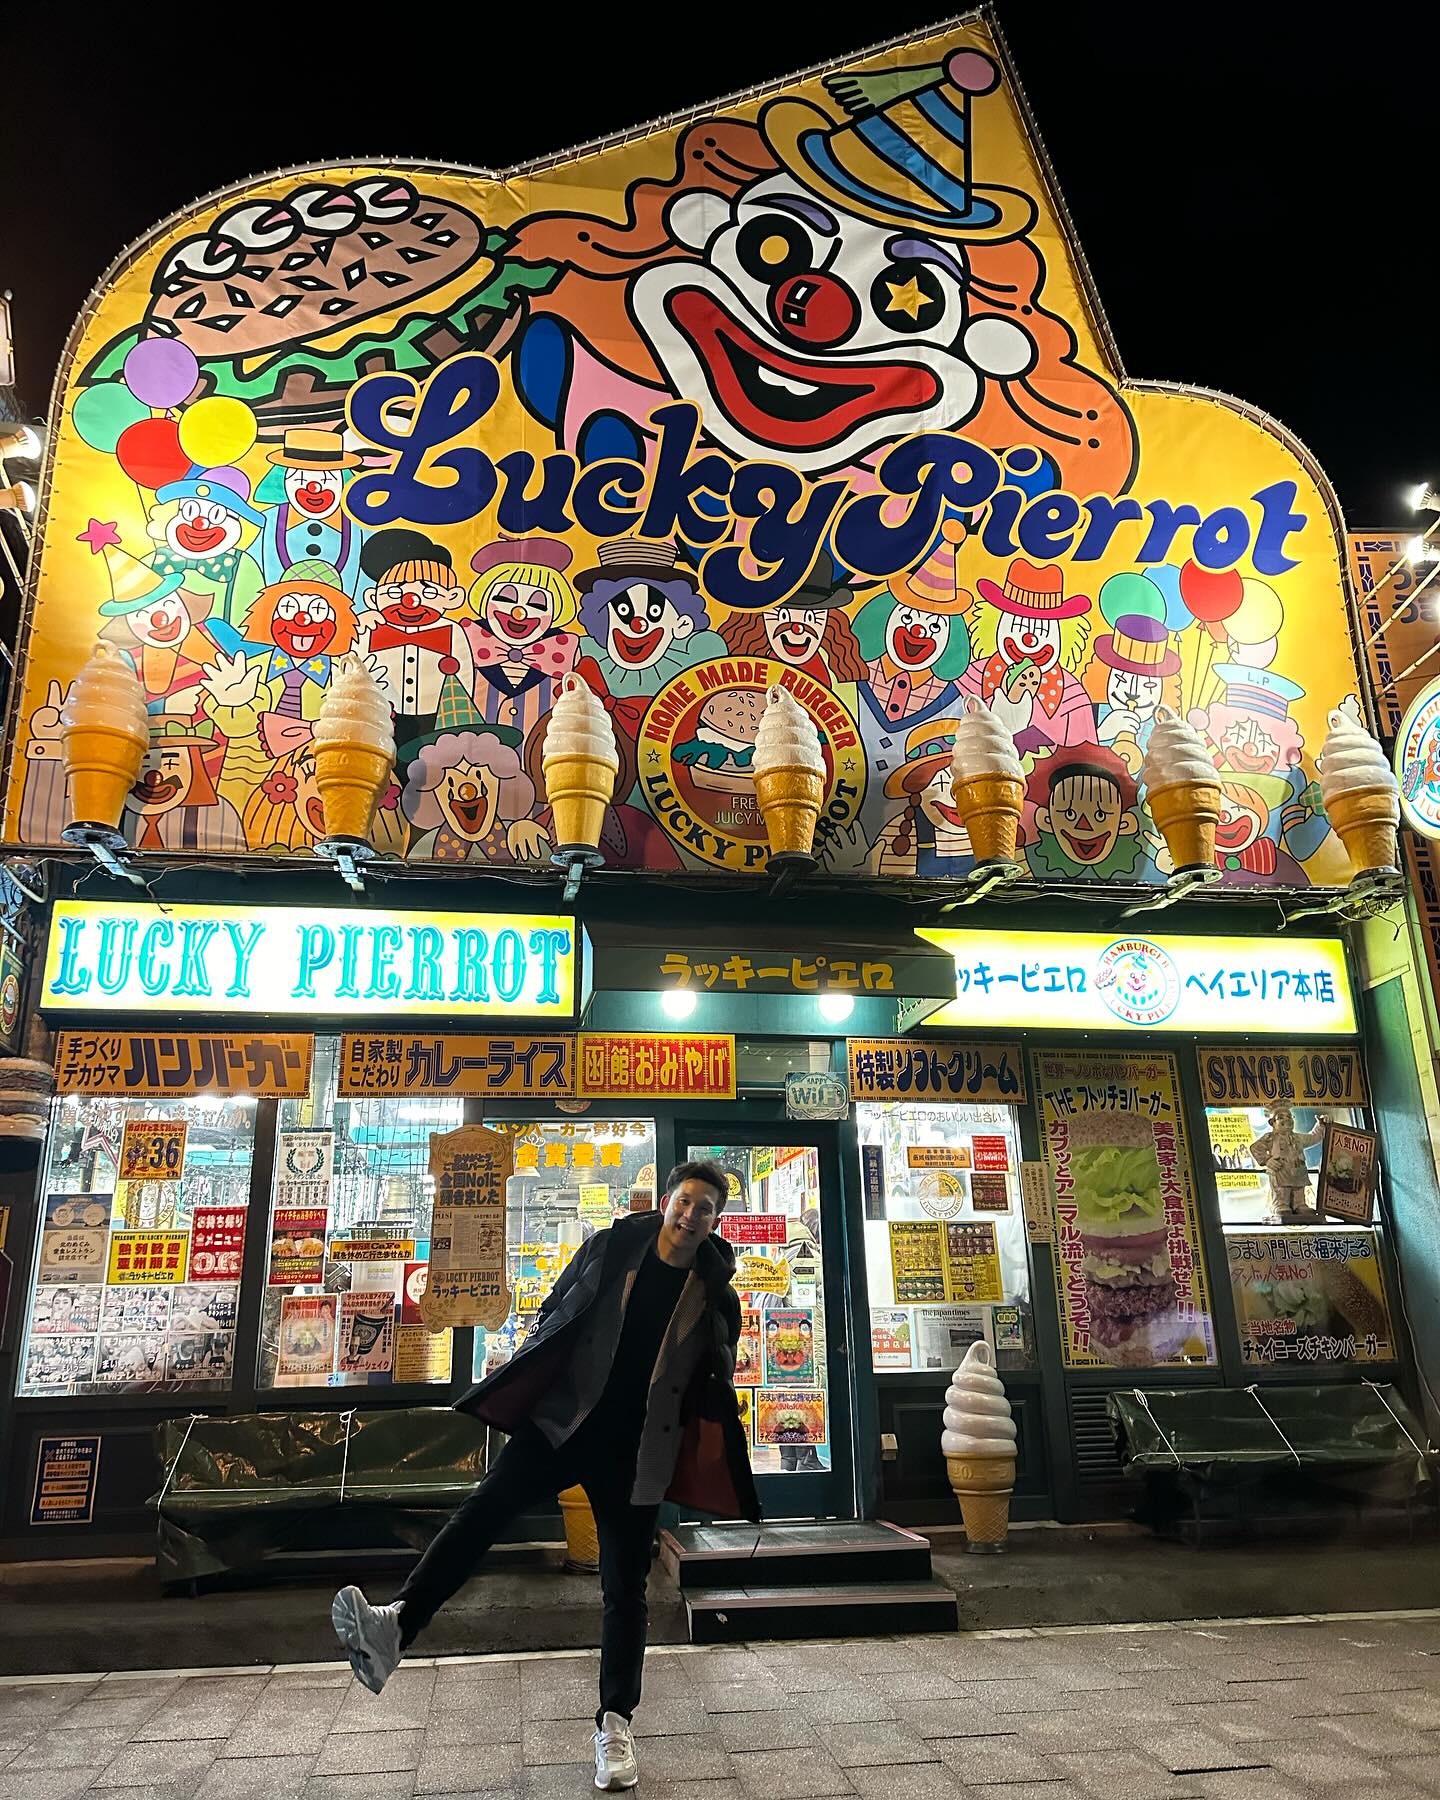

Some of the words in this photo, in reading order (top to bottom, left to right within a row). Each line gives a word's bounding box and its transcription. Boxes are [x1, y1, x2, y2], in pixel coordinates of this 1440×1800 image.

[341, 351, 850, 609] Lucky
[830, 431, 1308, 579] Pierrot
[644, 681, 697, 744] HOME
[695, 661, 769, 691] MADE
[780, 668, 857, 751] BURGER
[645, 771, 737, 860] LUCKY
[715, 812, 751, 826] JUICY
[50, 916, 266, 999] LUCKY
[290, 922, 571, 1005] PIERROT
[660, 953, 895, 991] ラッキーピエロ
[954, 961, 1088, 994] ッキーピエロ
[1185, 969, 1335, 1004] ベイエリア本店
[68, 1036, 121, 1061] 手づくり
[123, 1037, 303, 1088] ハンバーガー
[350, 1038, 403, 1063] 自家製
[404, 1040, 568, 1089] カレーライス
[584, 1044, 730, 1087] 函館おみやげ
[63, 1063, 120, 1087] デカウマ
[349, 1064, 399, 1089] こだわり
[855, 1050, 895, 1092] 特製
[895, 1048, 1020, 1095] ソフトクリーム
[1206, 1054, 1295, 1100] SINCE
[1298, 1054, 1353, 1099] 1987
[1044, 1086, 1078, 1118] THE
[1077, 1084, 1171, 1117] フトッチョバーガー
[149, 1137, 181, 1169] 36
[432, 1283, 500, 1298] ラッキーピエロ
[445, 1271, 468, 1283] LUCKY
[469, 1270, 500, 1282] PIERROT
[933, 1309, 951, 1318] Japan
